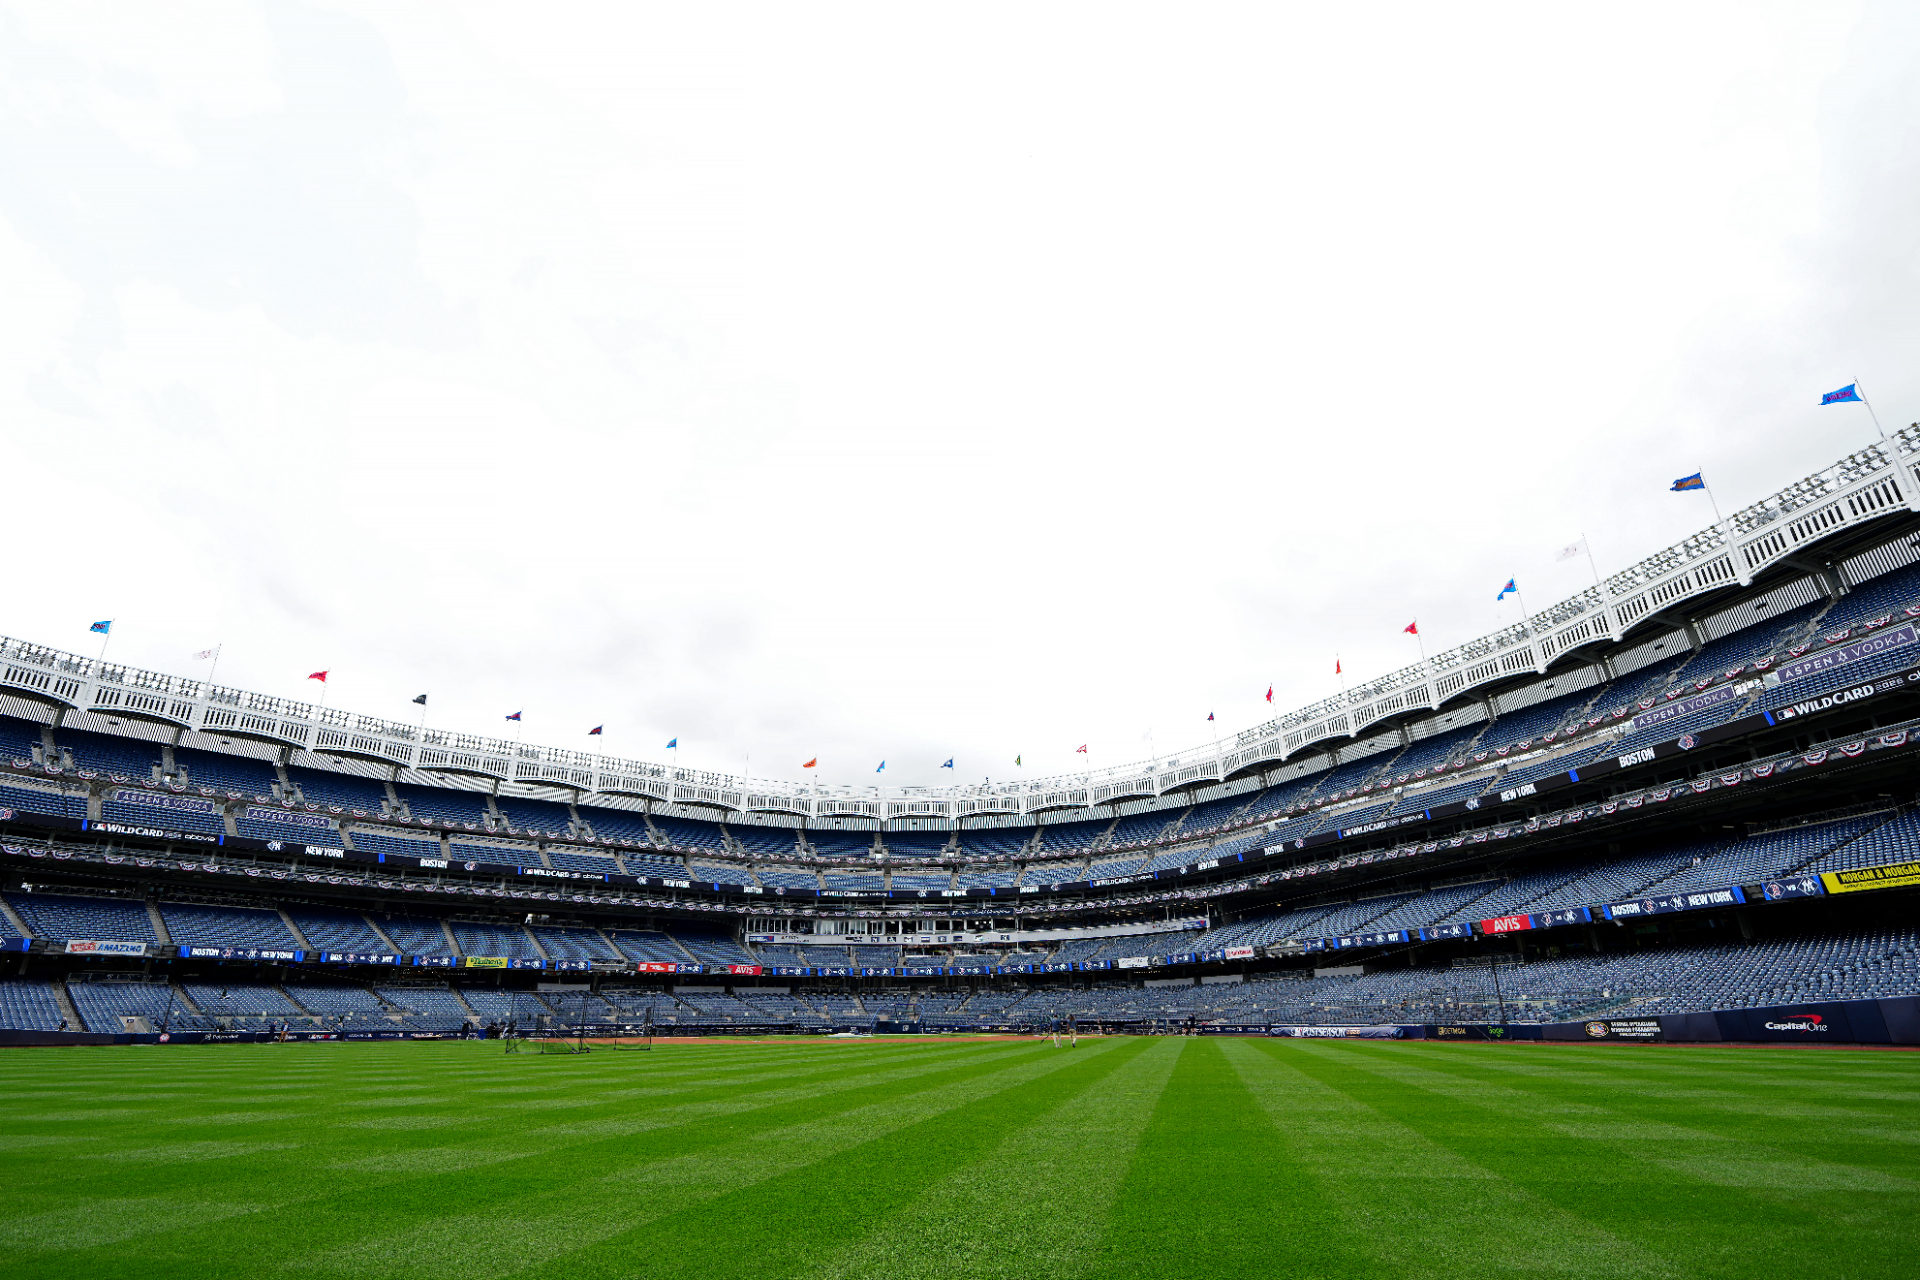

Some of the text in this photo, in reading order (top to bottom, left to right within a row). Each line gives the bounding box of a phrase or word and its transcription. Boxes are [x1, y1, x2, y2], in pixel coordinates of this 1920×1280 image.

[1785, 633, 1907, 678] ASPEN VODKA
[1793, 698, 1833, 716] WILD
[1832, 684, 1874, 705] CARD
[1639, 691, 1729, 726] ASPEN VODKA
[1618, 747, 1656, 768] BOSTON
[1500, 783, 1537, 802] NEW YORK
[122, 793, 208, 811] ASPEN VODKA
[251, 810, 326, 826] ASPEN VODKA
[305, 846, 345, 858] NEW YORK
[1264, 844, 1284, 856] BOSTON
[420, 858, 448, 869] BOSTON
[1840, 869, 1874, 883] MORGAN
[1875, 868, 1884, 879] &
[1883, 863, 1920, 878] MORGAN
[1611, 903, 1641, 916] BOSTON
[1687, 894, 1708, 907] NEW
[1708, 890, 1733, 904] YORK
[1494, 917, 1521, 932] AVIS
[98, 943, 142, 953] AMAZING
[191, 948, 219, 957] BOSTON
[276, 951, 294, 959] YORK
[735, 965, 754, 975] AVIS
[1301, 1027, 1345, 1037] POSTSEASON
